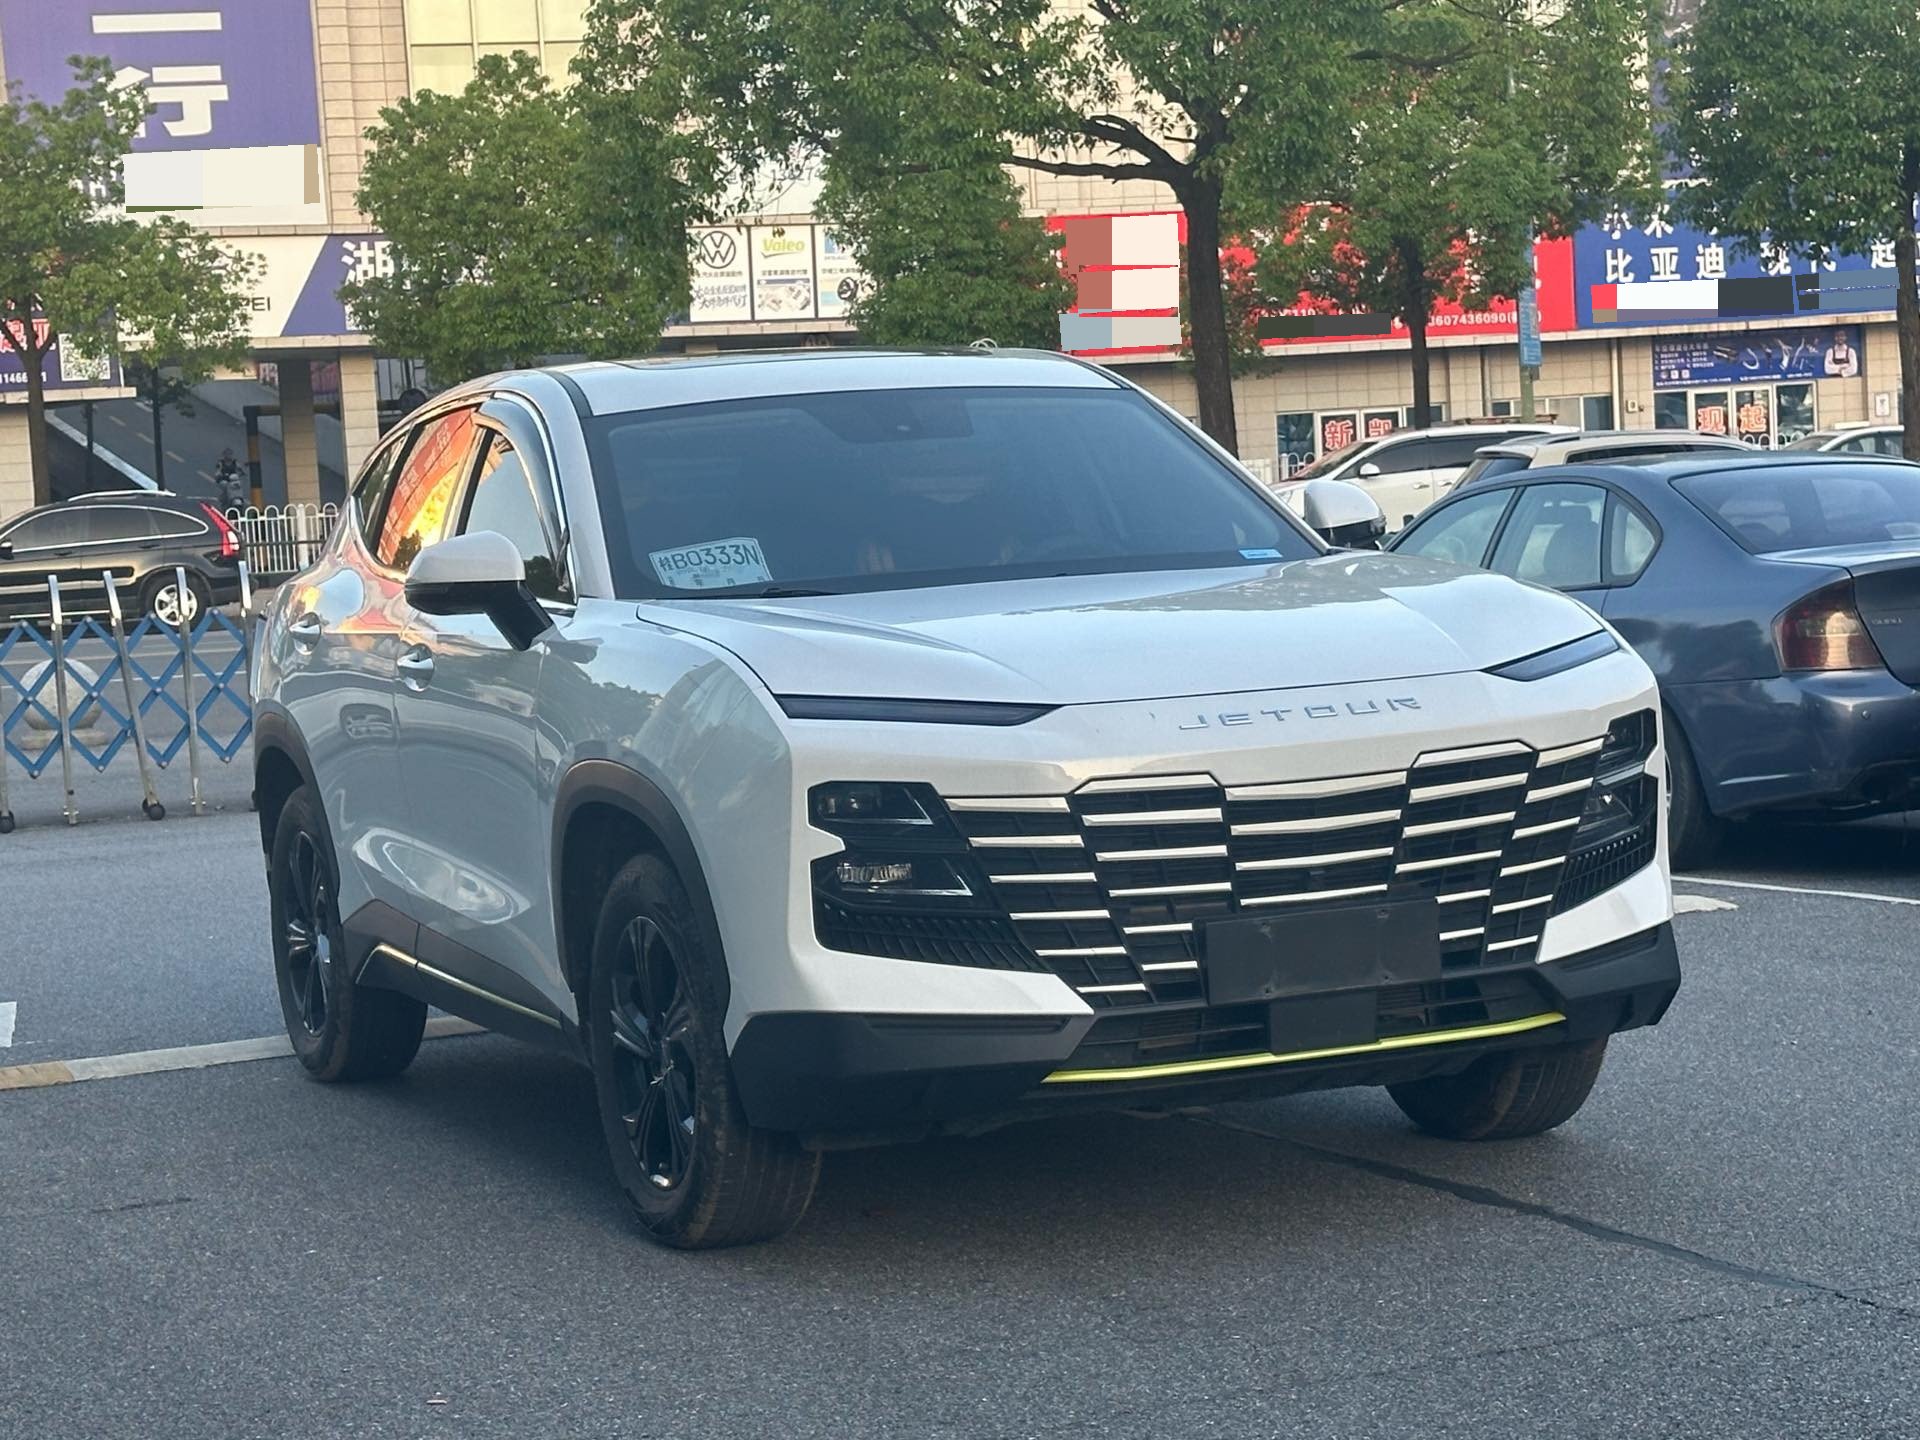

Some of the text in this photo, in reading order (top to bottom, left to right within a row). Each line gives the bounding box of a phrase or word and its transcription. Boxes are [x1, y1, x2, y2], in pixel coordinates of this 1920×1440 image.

[762, 238, 805, 253] Valeo
[1605, 243, 1727, 284] 比亚迪
[1325, 419, 1353, 450] 新
[1698, 404, 1767, 434] 现 起
[1178, 696, 1422, 730] JETOUR
